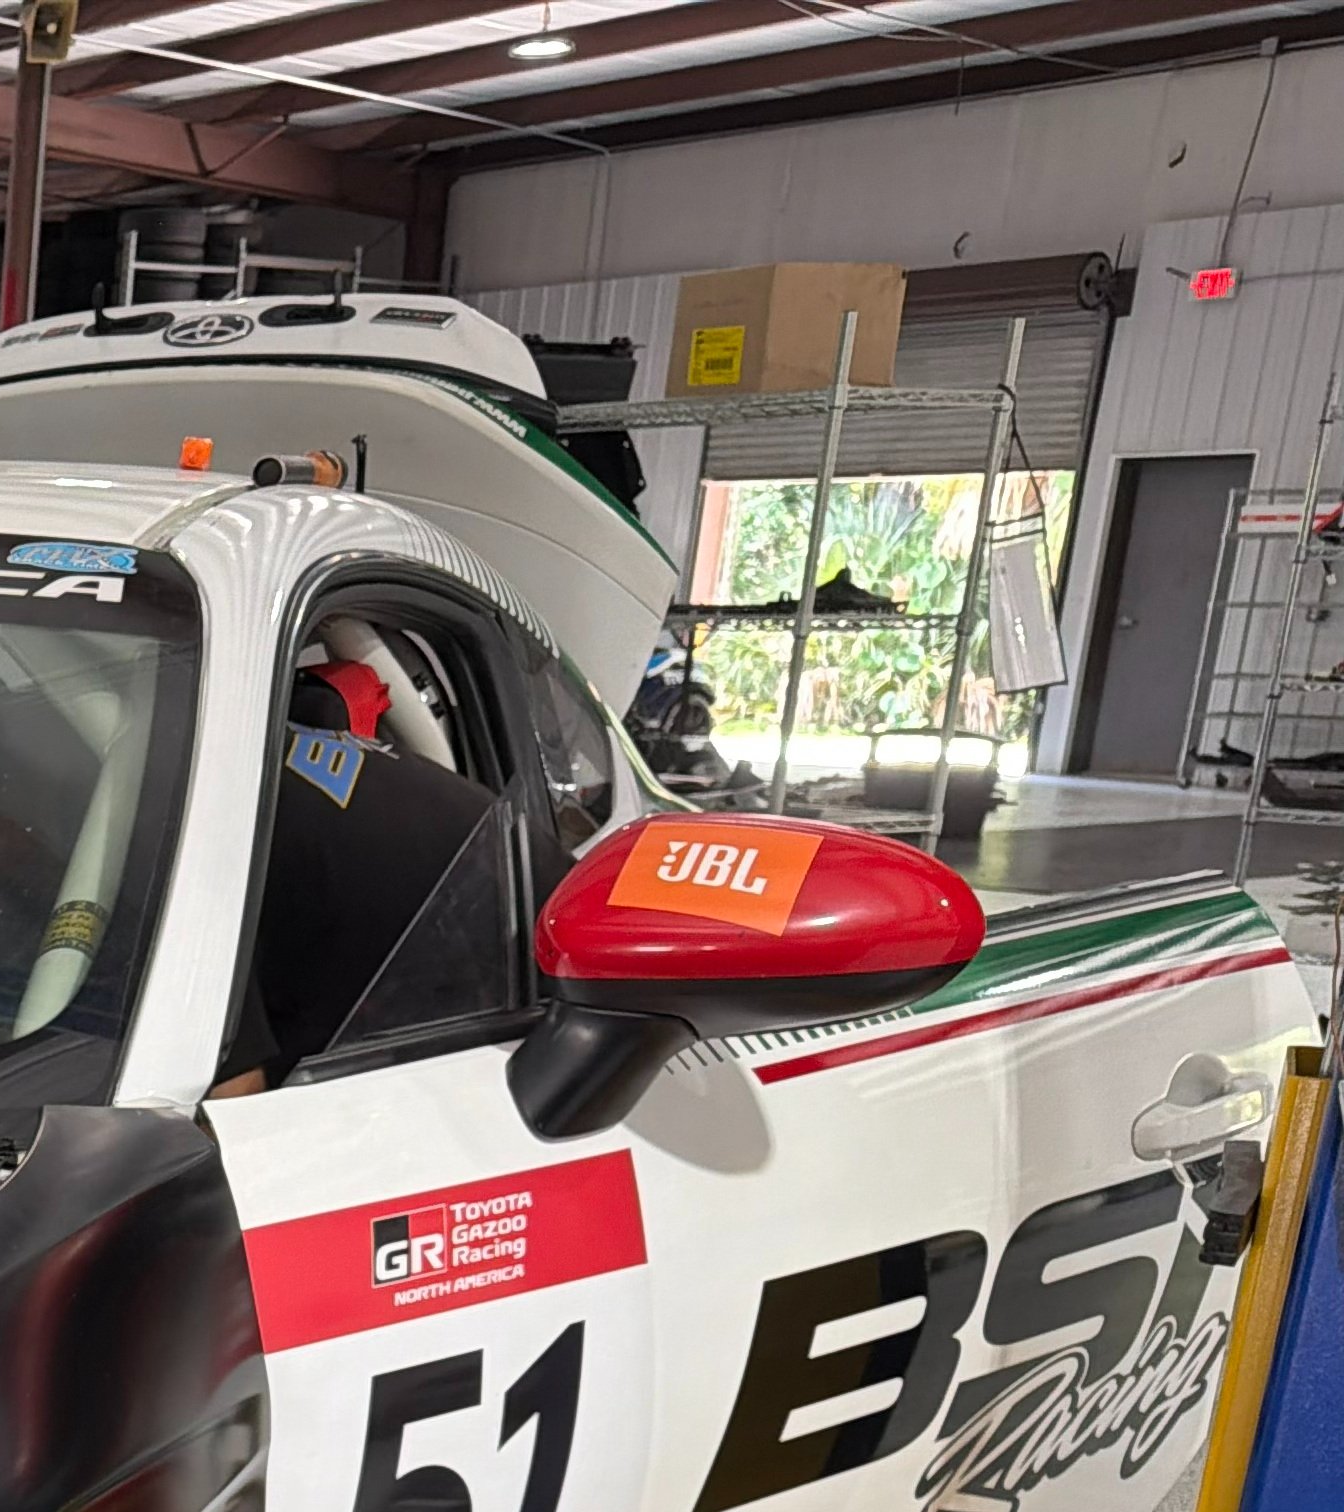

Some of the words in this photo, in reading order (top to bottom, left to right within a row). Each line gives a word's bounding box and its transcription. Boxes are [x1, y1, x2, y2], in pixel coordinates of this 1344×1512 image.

[656, 840, 769, 896] JBL
[451, 1214, 528, 1245] GAZOO
[374, 1232, 445, 1282] GR
[451, 1237, 527, 1267] Racing
[393, 1280, 452, 1307] NORTH
[453, 1263, 526, 1293] AMERICA
